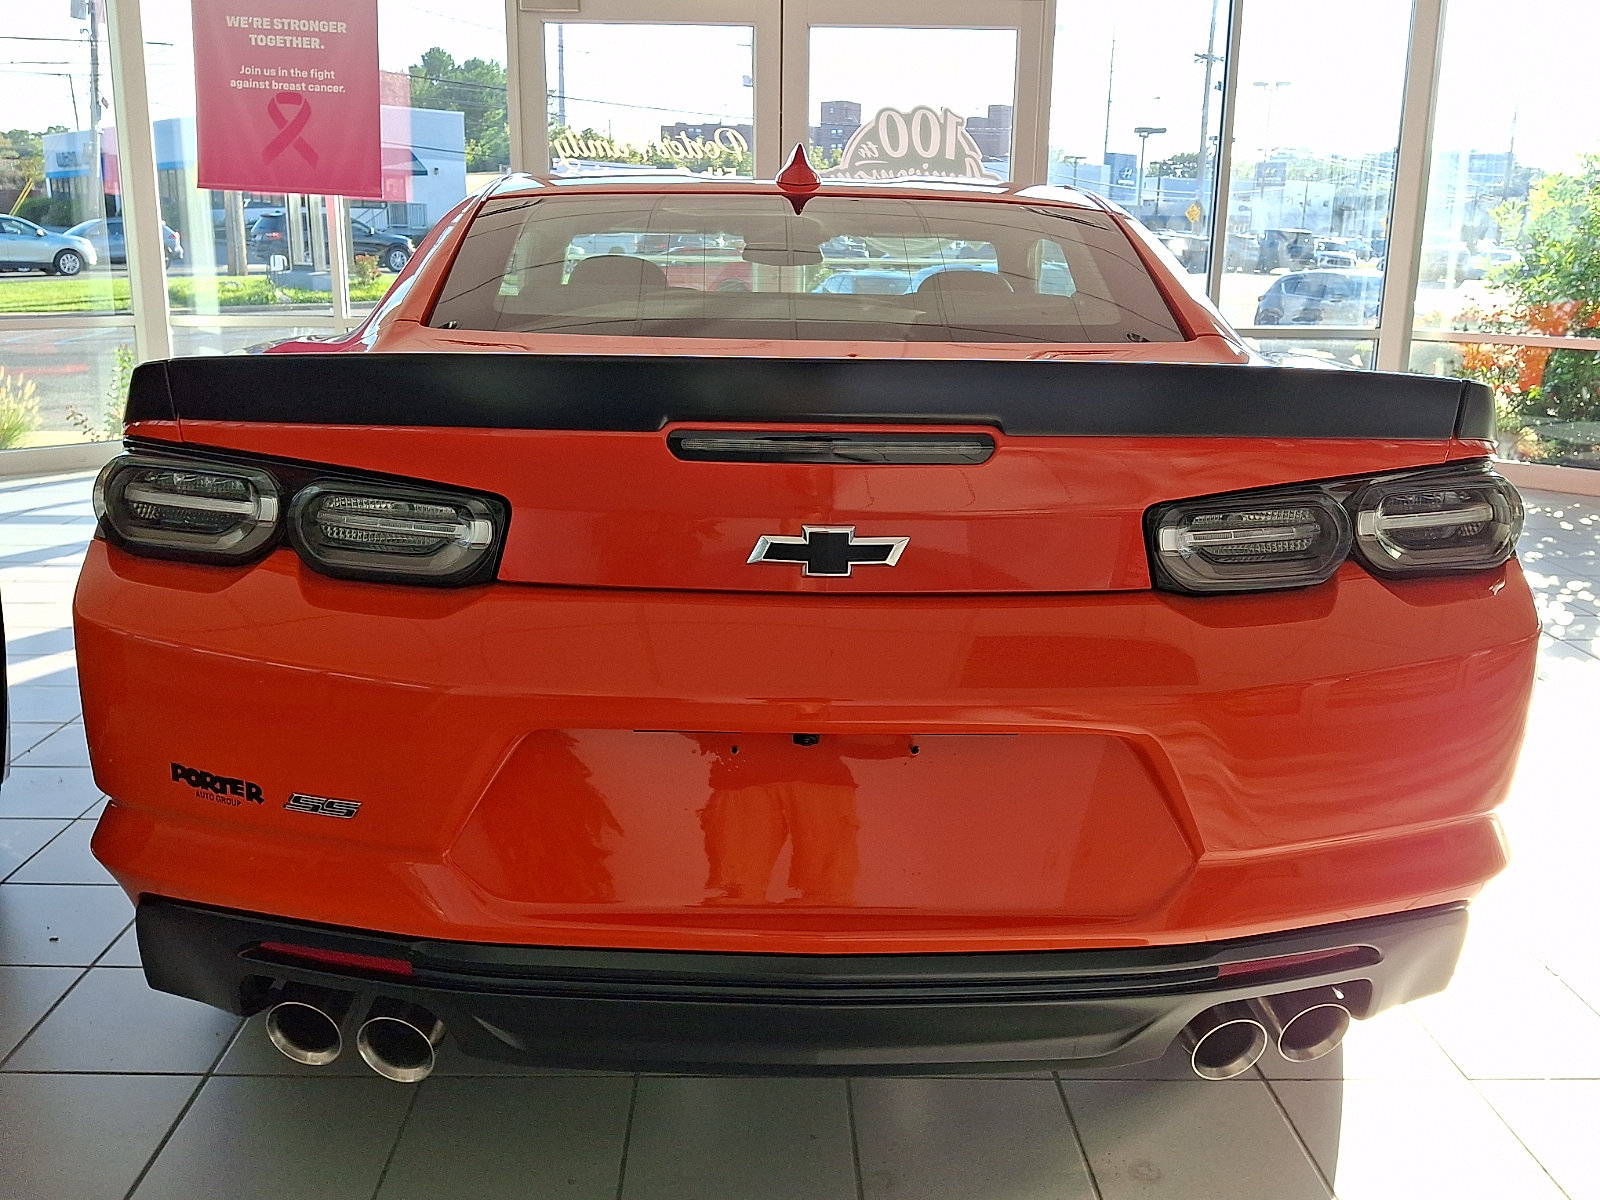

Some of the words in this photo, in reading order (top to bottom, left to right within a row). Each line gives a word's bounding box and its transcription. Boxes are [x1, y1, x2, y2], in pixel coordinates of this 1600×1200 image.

[226, 15, 271, 29] WE'RE
[273, 18, 347, 33] STRONGER
[249, 34, 325, 49] TOGETHER.
[240, 65, 261, 75] Join
[264, 68, 276, 76] us
[278, 67, 288, 77] in
[290, 68, 308, 78] the
[310, 69, 335, 81] fight
[230, 78, 270, 89] against
[272, 80, 306, 91] breast
[308, 84, 346, 93] cancer.
[171, 762, 264, 804] PORTER
[196, 790, 214, 801] AUTO
[216, 795, 241, 807] GROUP
[283, 792, 363, 819] SS
